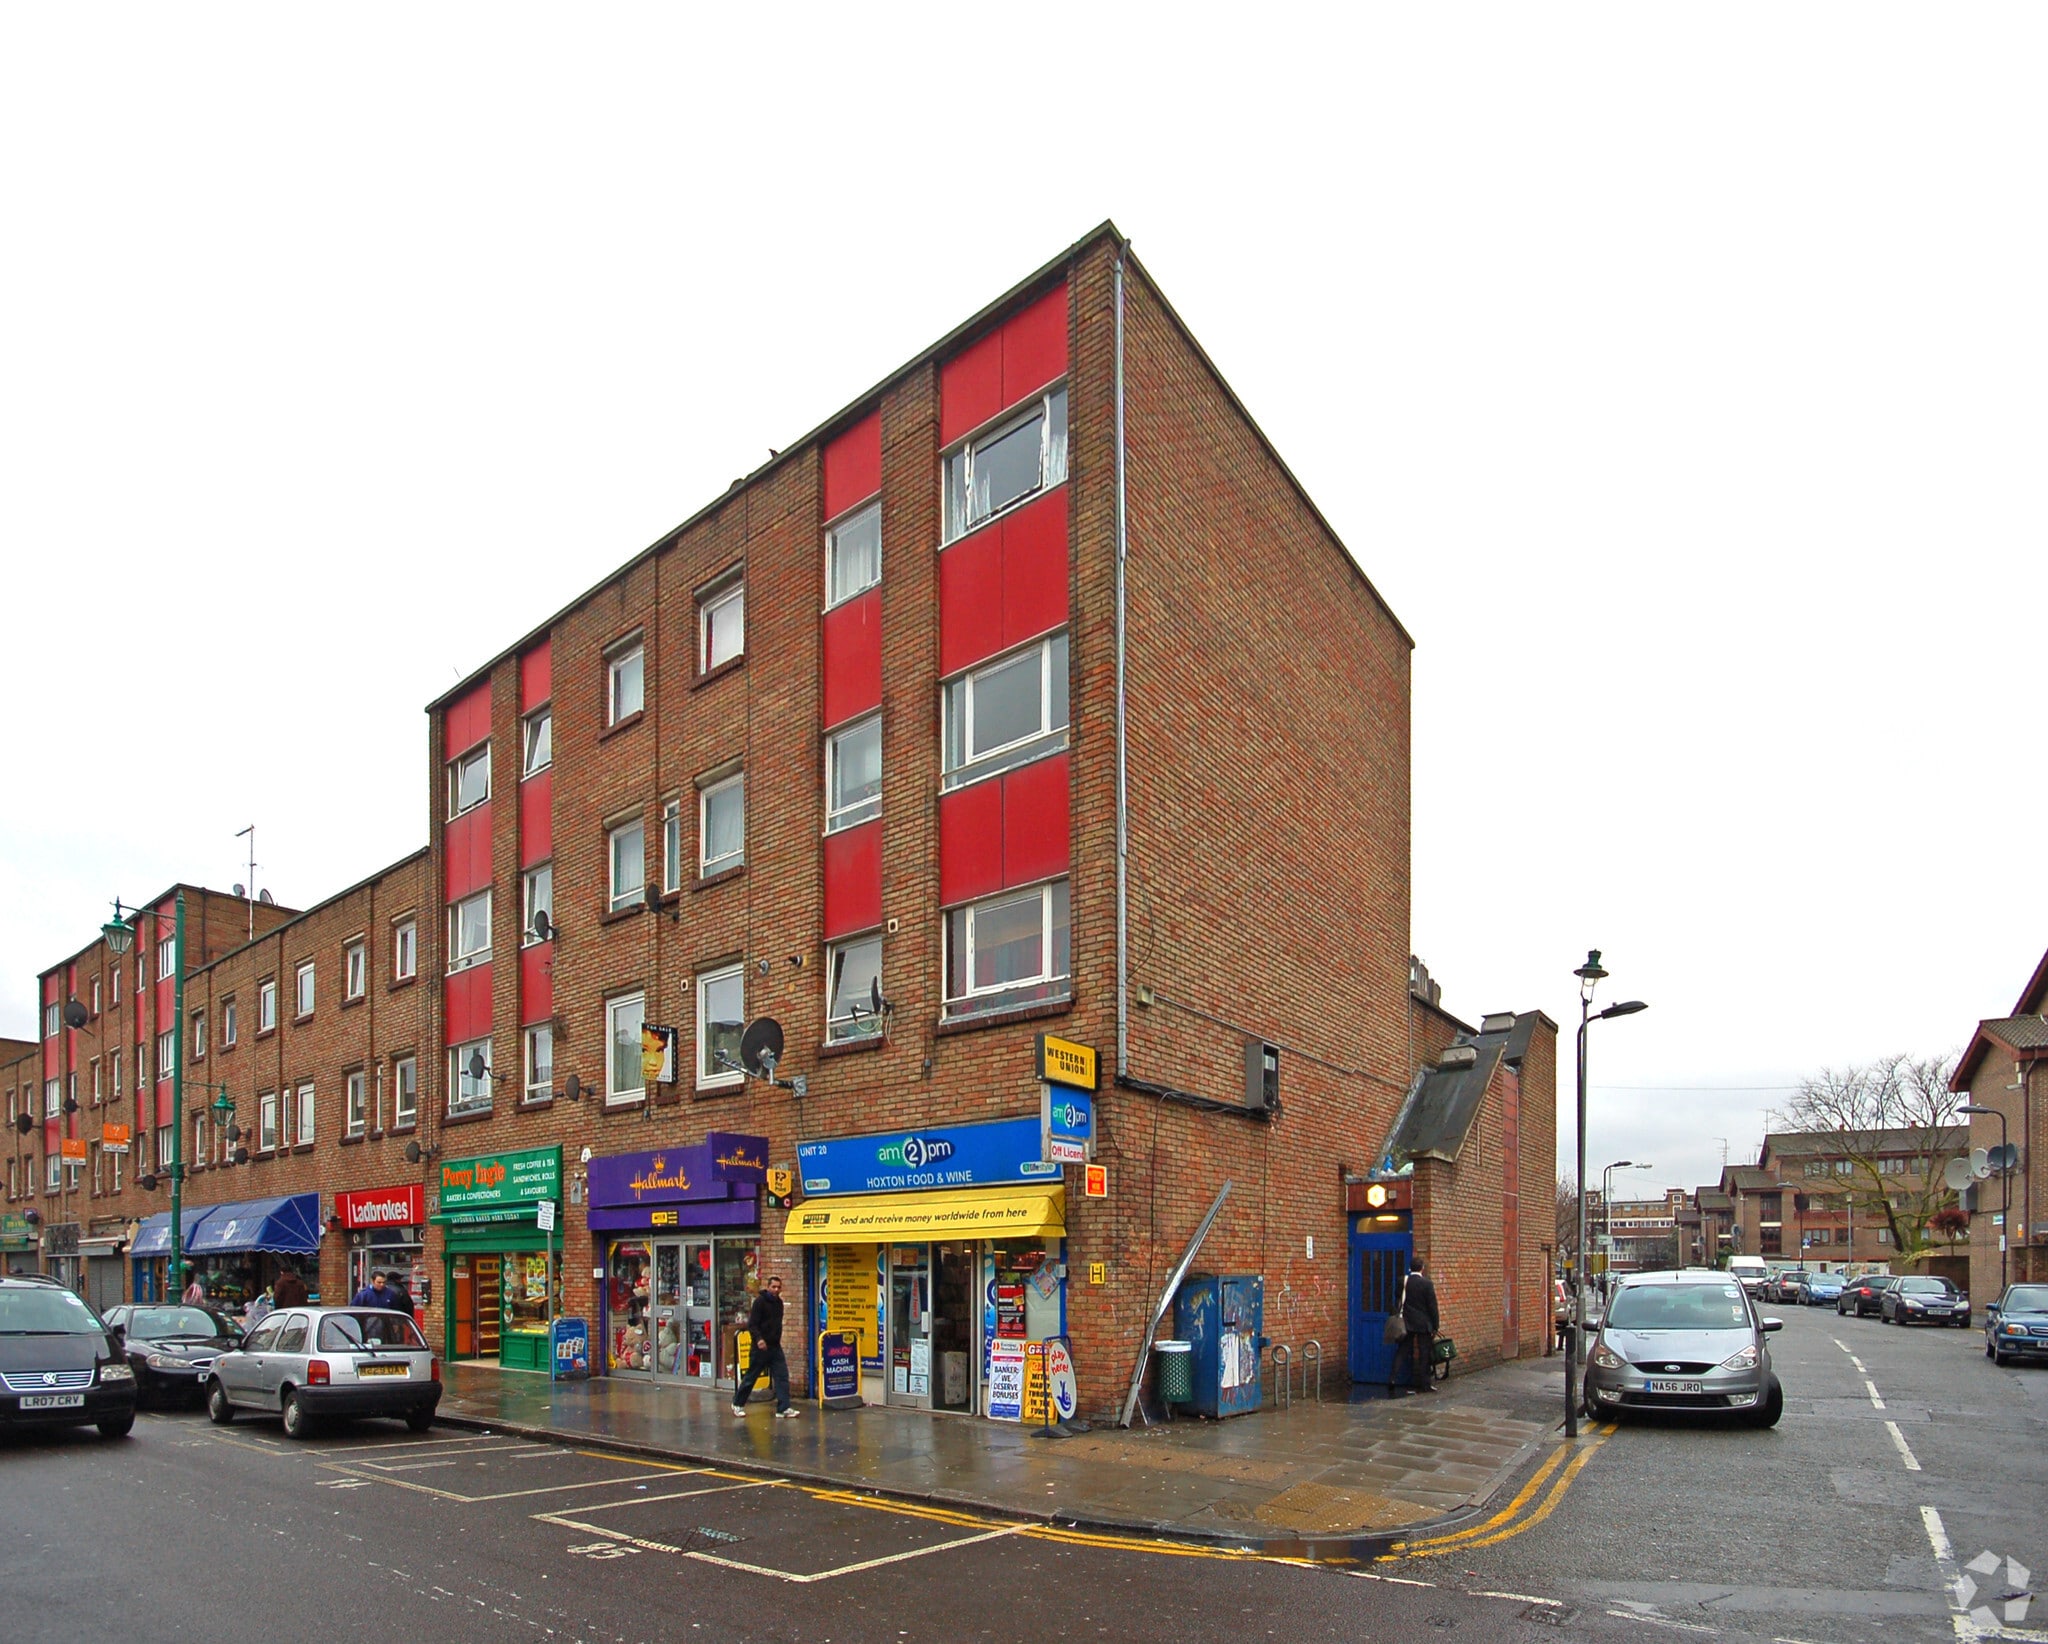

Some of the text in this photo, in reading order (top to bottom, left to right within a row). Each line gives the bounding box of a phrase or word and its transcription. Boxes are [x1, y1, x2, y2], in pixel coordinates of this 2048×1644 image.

[1047, 1047, 1085, 1066] WESTERN
[1060, 1060, 1085, 1075] UNION
[800, 1145, 827, 1157] UNIT 20
[1051, 1145, 1063, 1157] Off
[716, 1153, 764, 1171] Hallmark
[442, 1161, 505, 1190] Percy Ingle
[867, 1170, 973, 1188] HOXTON FOOD & WINE
[629, 1166, 691, 1200] Hallmark
[352, 1199, 409, 1223] Ladbrokes
[840, 1208, 1028, 1225] Send and receive money worldwide from here
[832, 1358, 849, 1366] CASH
[1051, 1350, 1066, 1363] play
[826, 1365, 855, 1374] MACHINE
[993, 1383, 1018, 1391] DESERVE
[1652, 1382, 1678, 1391] NA56
[24, 1396, 80, 1407] LR07 CRV
[992, 1391, 1019, 1400] BONUSES
